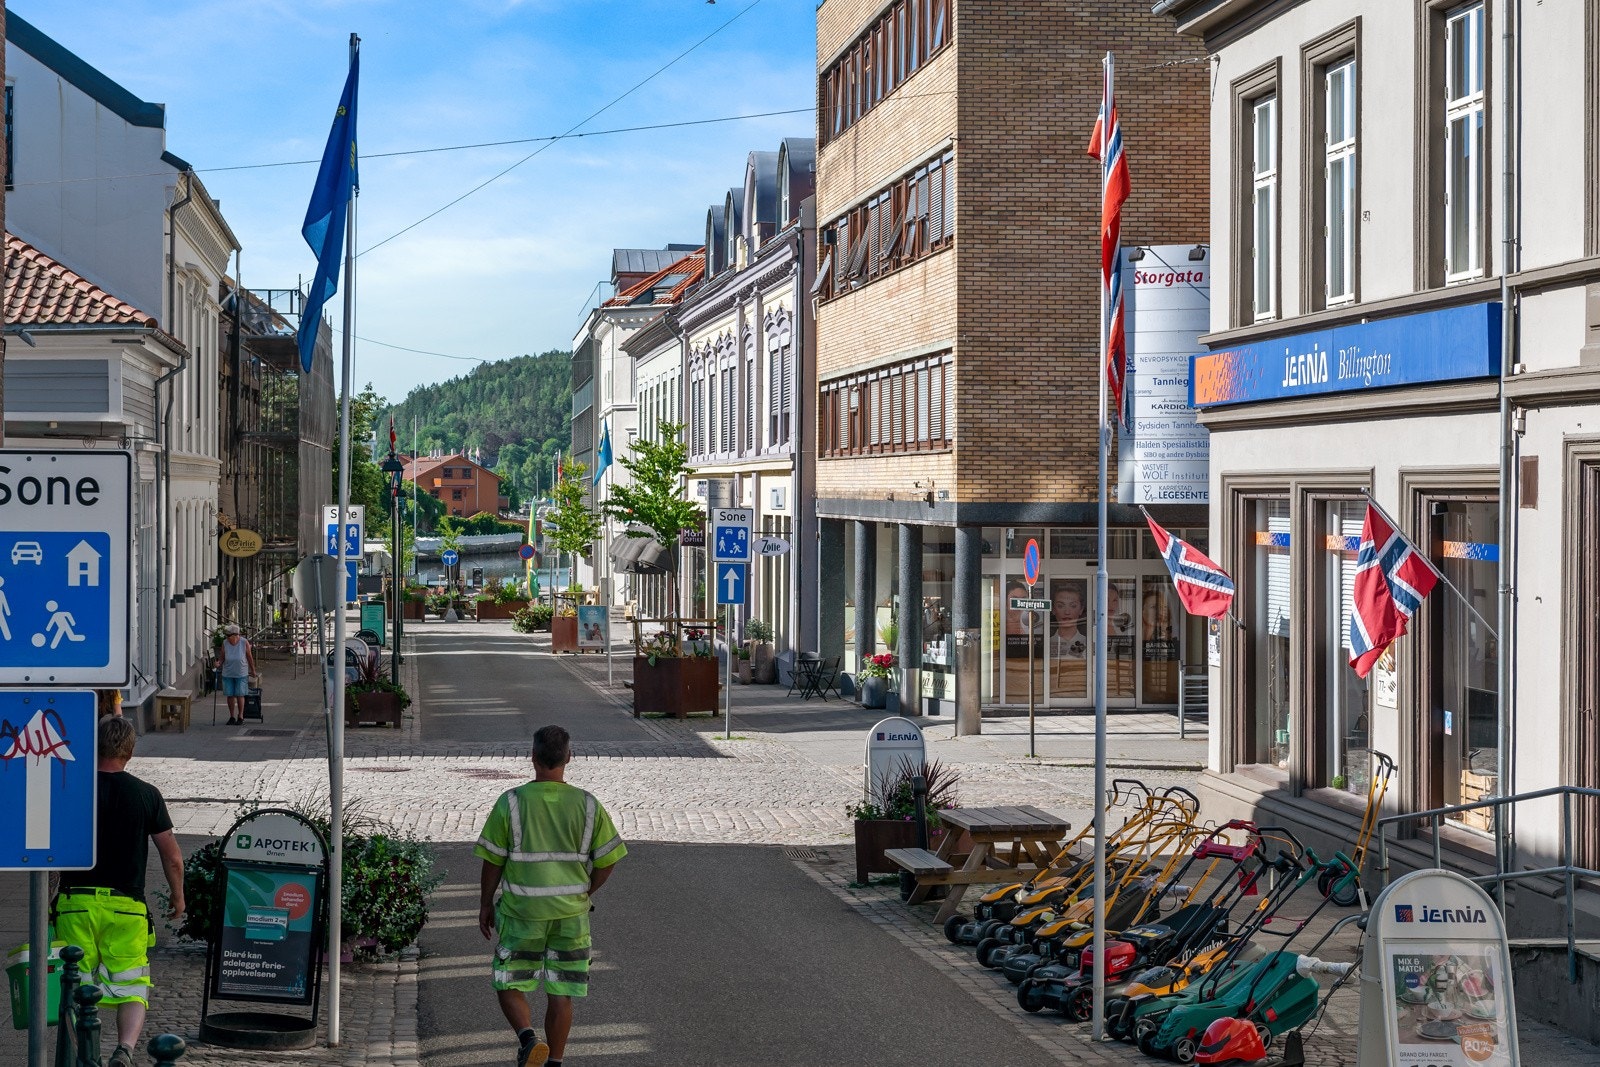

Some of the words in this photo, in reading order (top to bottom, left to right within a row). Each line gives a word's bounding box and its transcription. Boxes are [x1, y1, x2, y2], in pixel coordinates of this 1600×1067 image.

[1134, 270, 1203, 287] Storgata
[1338, 346, 1391, 386] Billington
[1153, 377, 1189, 387] Tannleg
[1138, 422, 1170, 431] Sydsiden
[1136, 441, 1160, 449] Halden
[1142, 471, 1169, 480] WOLF
[330, 509, 357, 519] Sne
[719, 511, 746, 522] Sone
[1017, 600, 1045, 609] Borgergata
[224, 949, 246, 958] Diaré
[247, 951, 262, 960] kan
[223, 959, 261, 970] ødelegge
[1398, 965, 1425, 973] MATCH
[222, 968, 277, 978] opplevelsene
